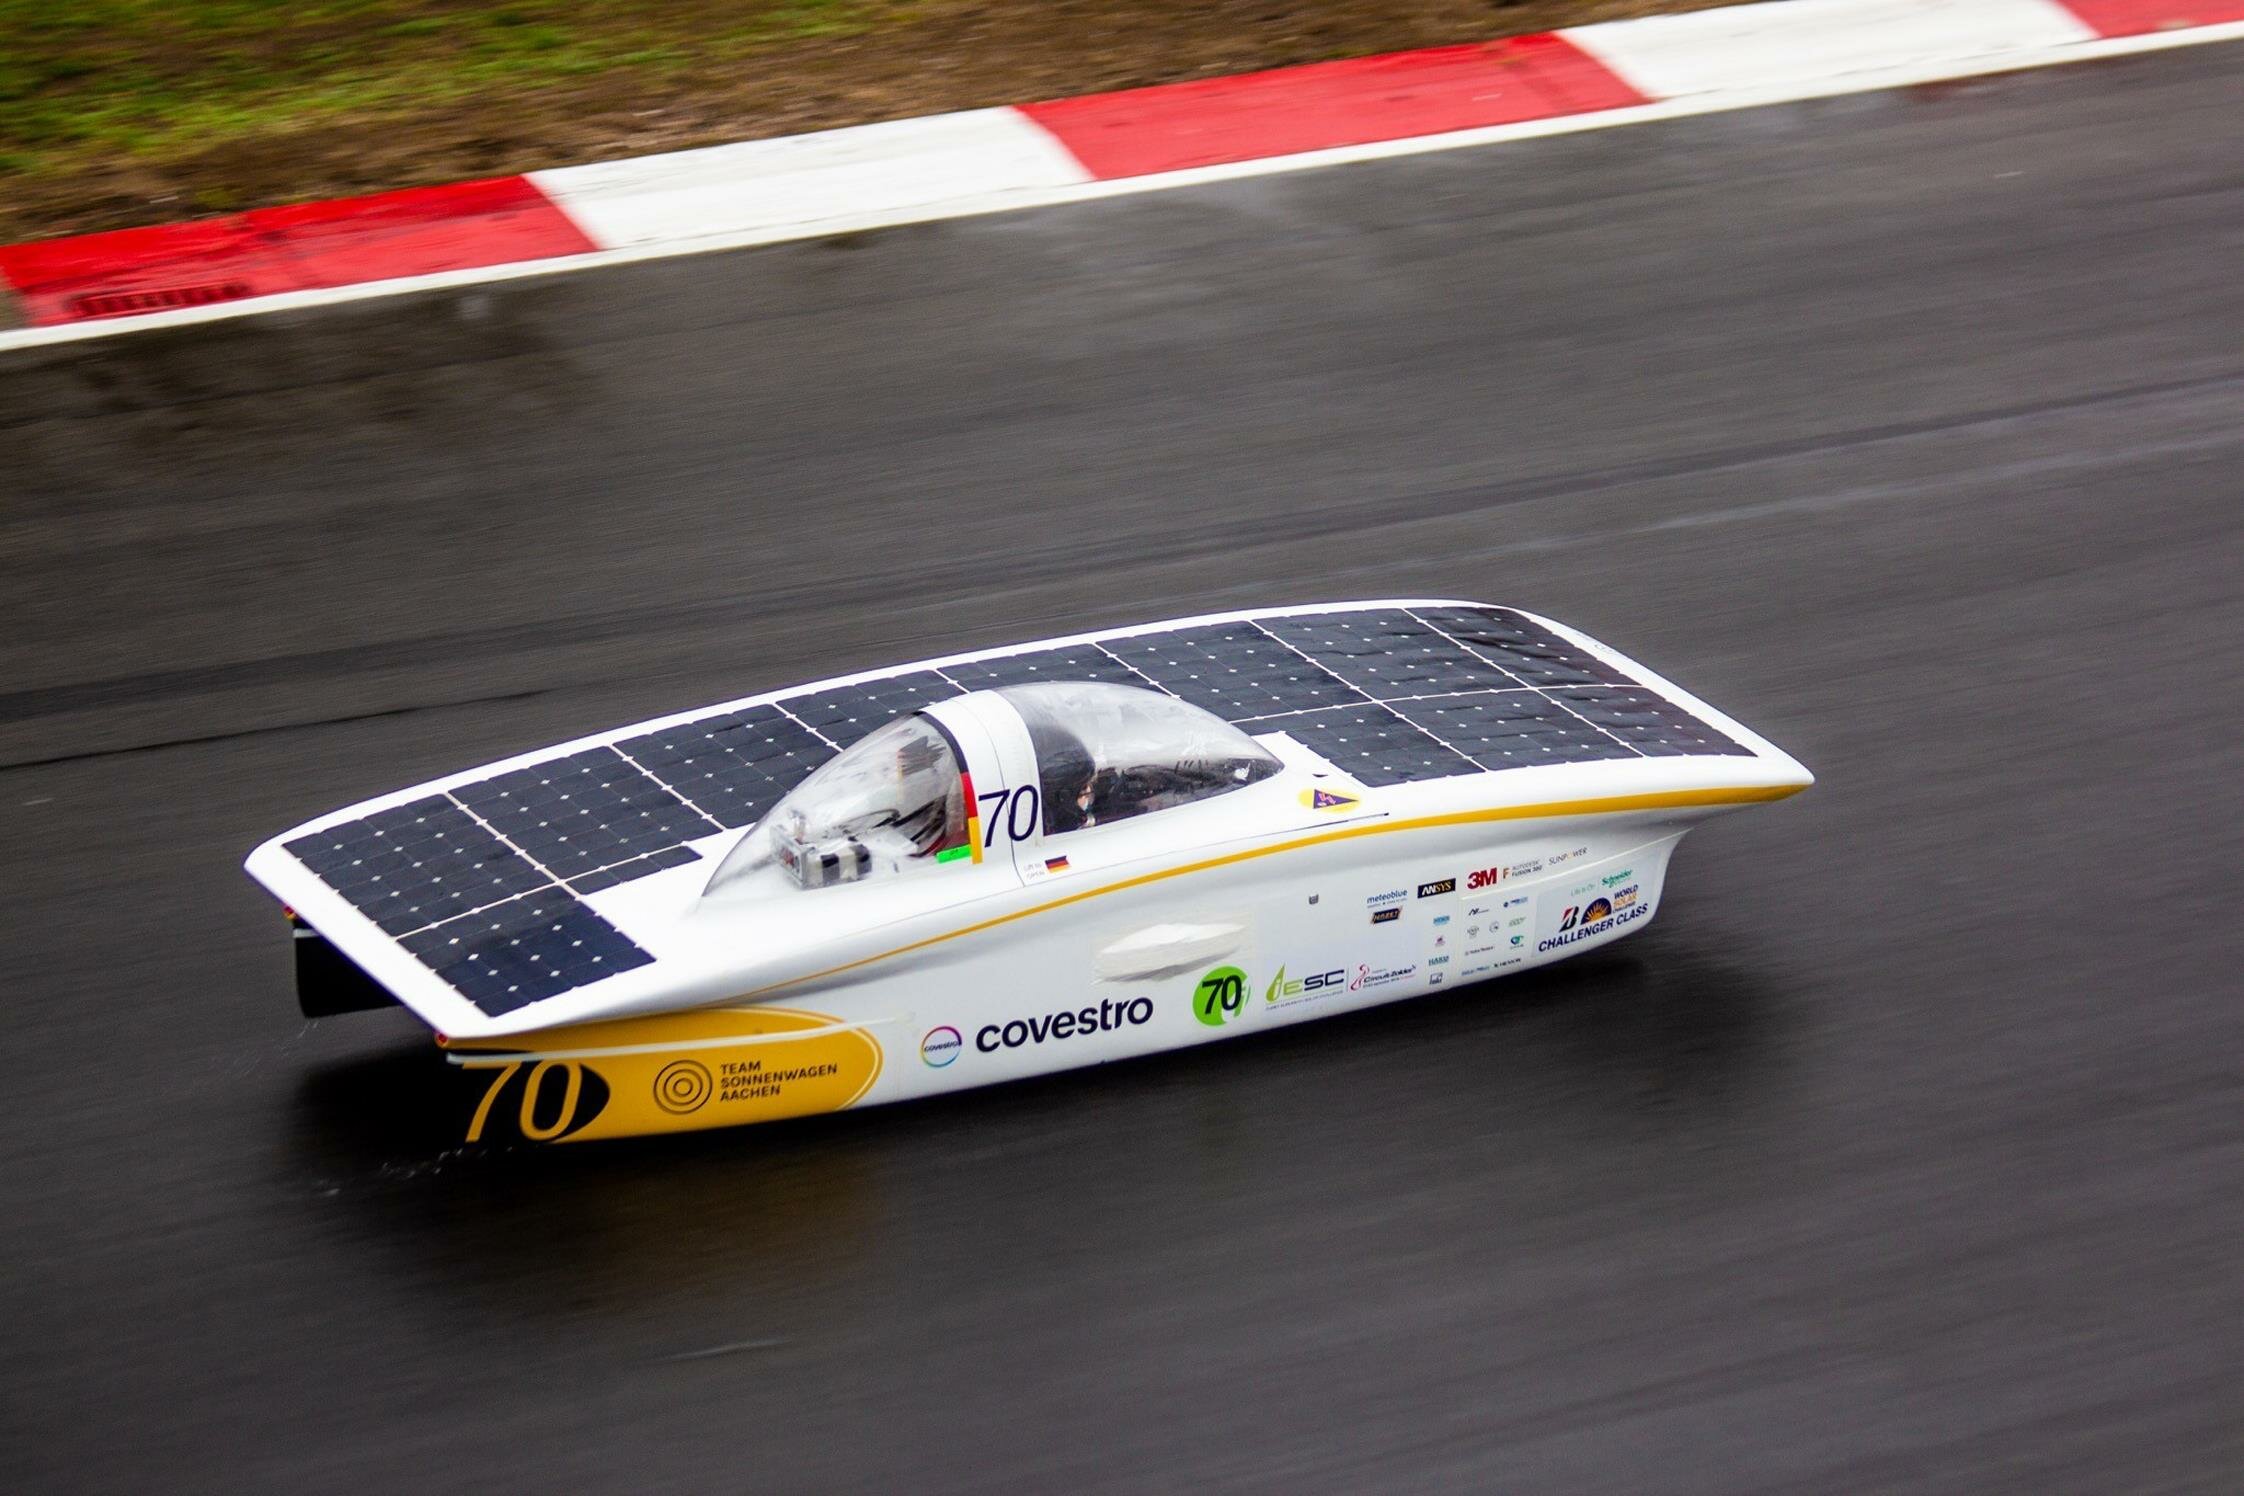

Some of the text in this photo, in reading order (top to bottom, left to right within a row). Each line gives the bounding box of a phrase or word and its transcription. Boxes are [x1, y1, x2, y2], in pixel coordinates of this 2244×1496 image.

[978, 783, 1039, 848] 70
[1421, 880, 1452, 896] ANSYS
[1467, 867, 1498, 890] 3M
[1366, 889, 1408, 904] meteoblue
[1614, 884, 1639, 899] WORLD
[1538, 903, 1649, 952] CHALLENGER CLASS
[1201, 974, 1242, 1016] 70
[975, 997, 1154, 1053] covestro
[924, 1040, 959, 1052] covestro
[720, 1061, 762, 1075] TEAM
[720, 1063, 839, 1089] SONNENWAGEN
[461, 1059, 583, 1142] 70
[720, 1084, 782, 1102] AACHEN
